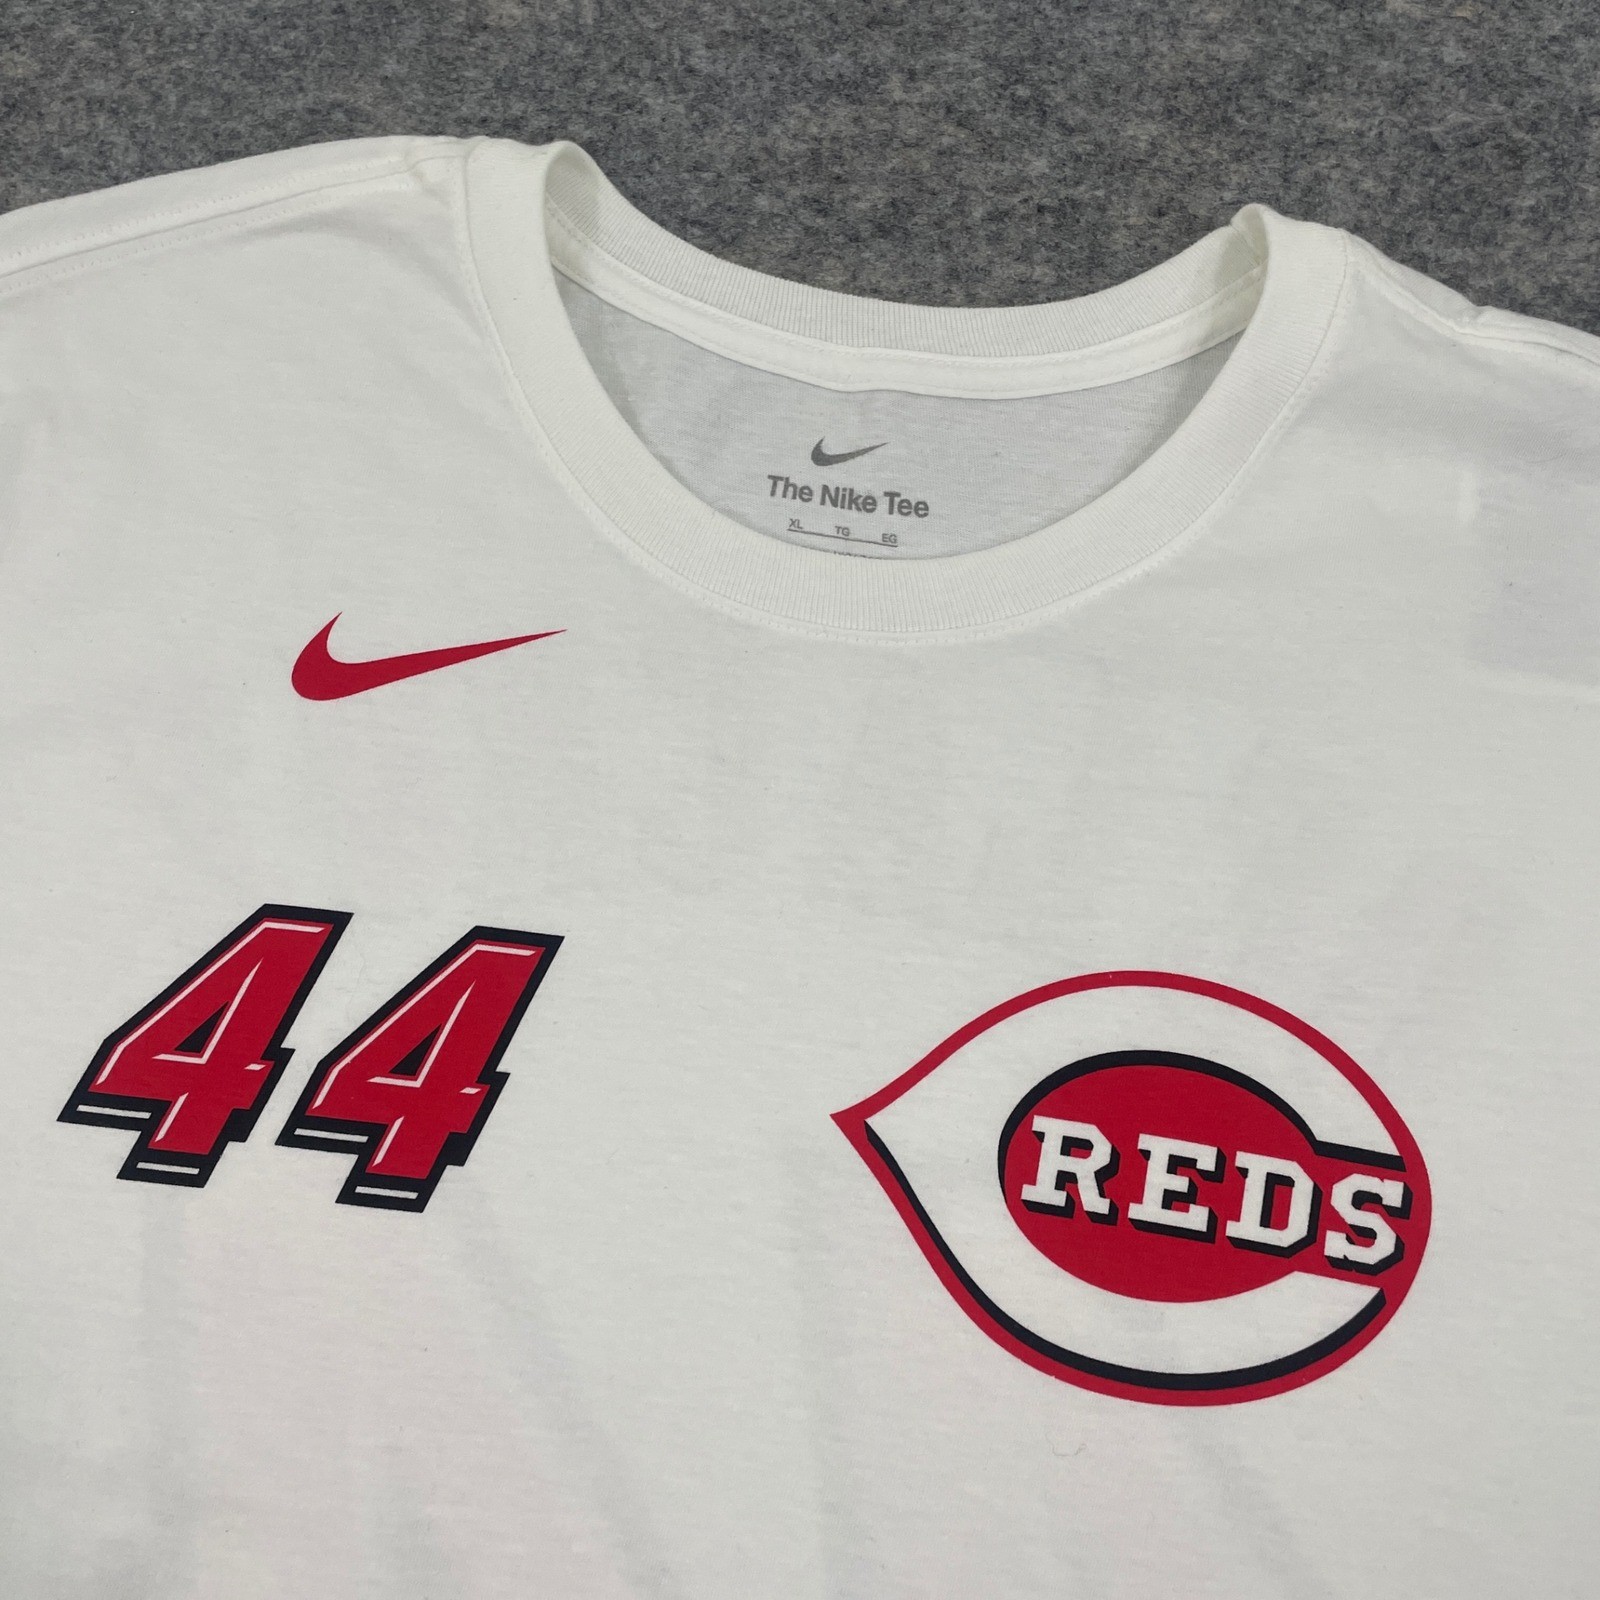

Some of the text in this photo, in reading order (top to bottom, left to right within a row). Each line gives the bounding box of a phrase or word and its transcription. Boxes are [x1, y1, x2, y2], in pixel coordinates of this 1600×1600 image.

[767, 474, 930, 519] The Nike Tee
[788, 518, 898, 544] XL TG EG
[56, 903, 565, 1213] 44
[1020, 1114, 1414, 1277] REDS
